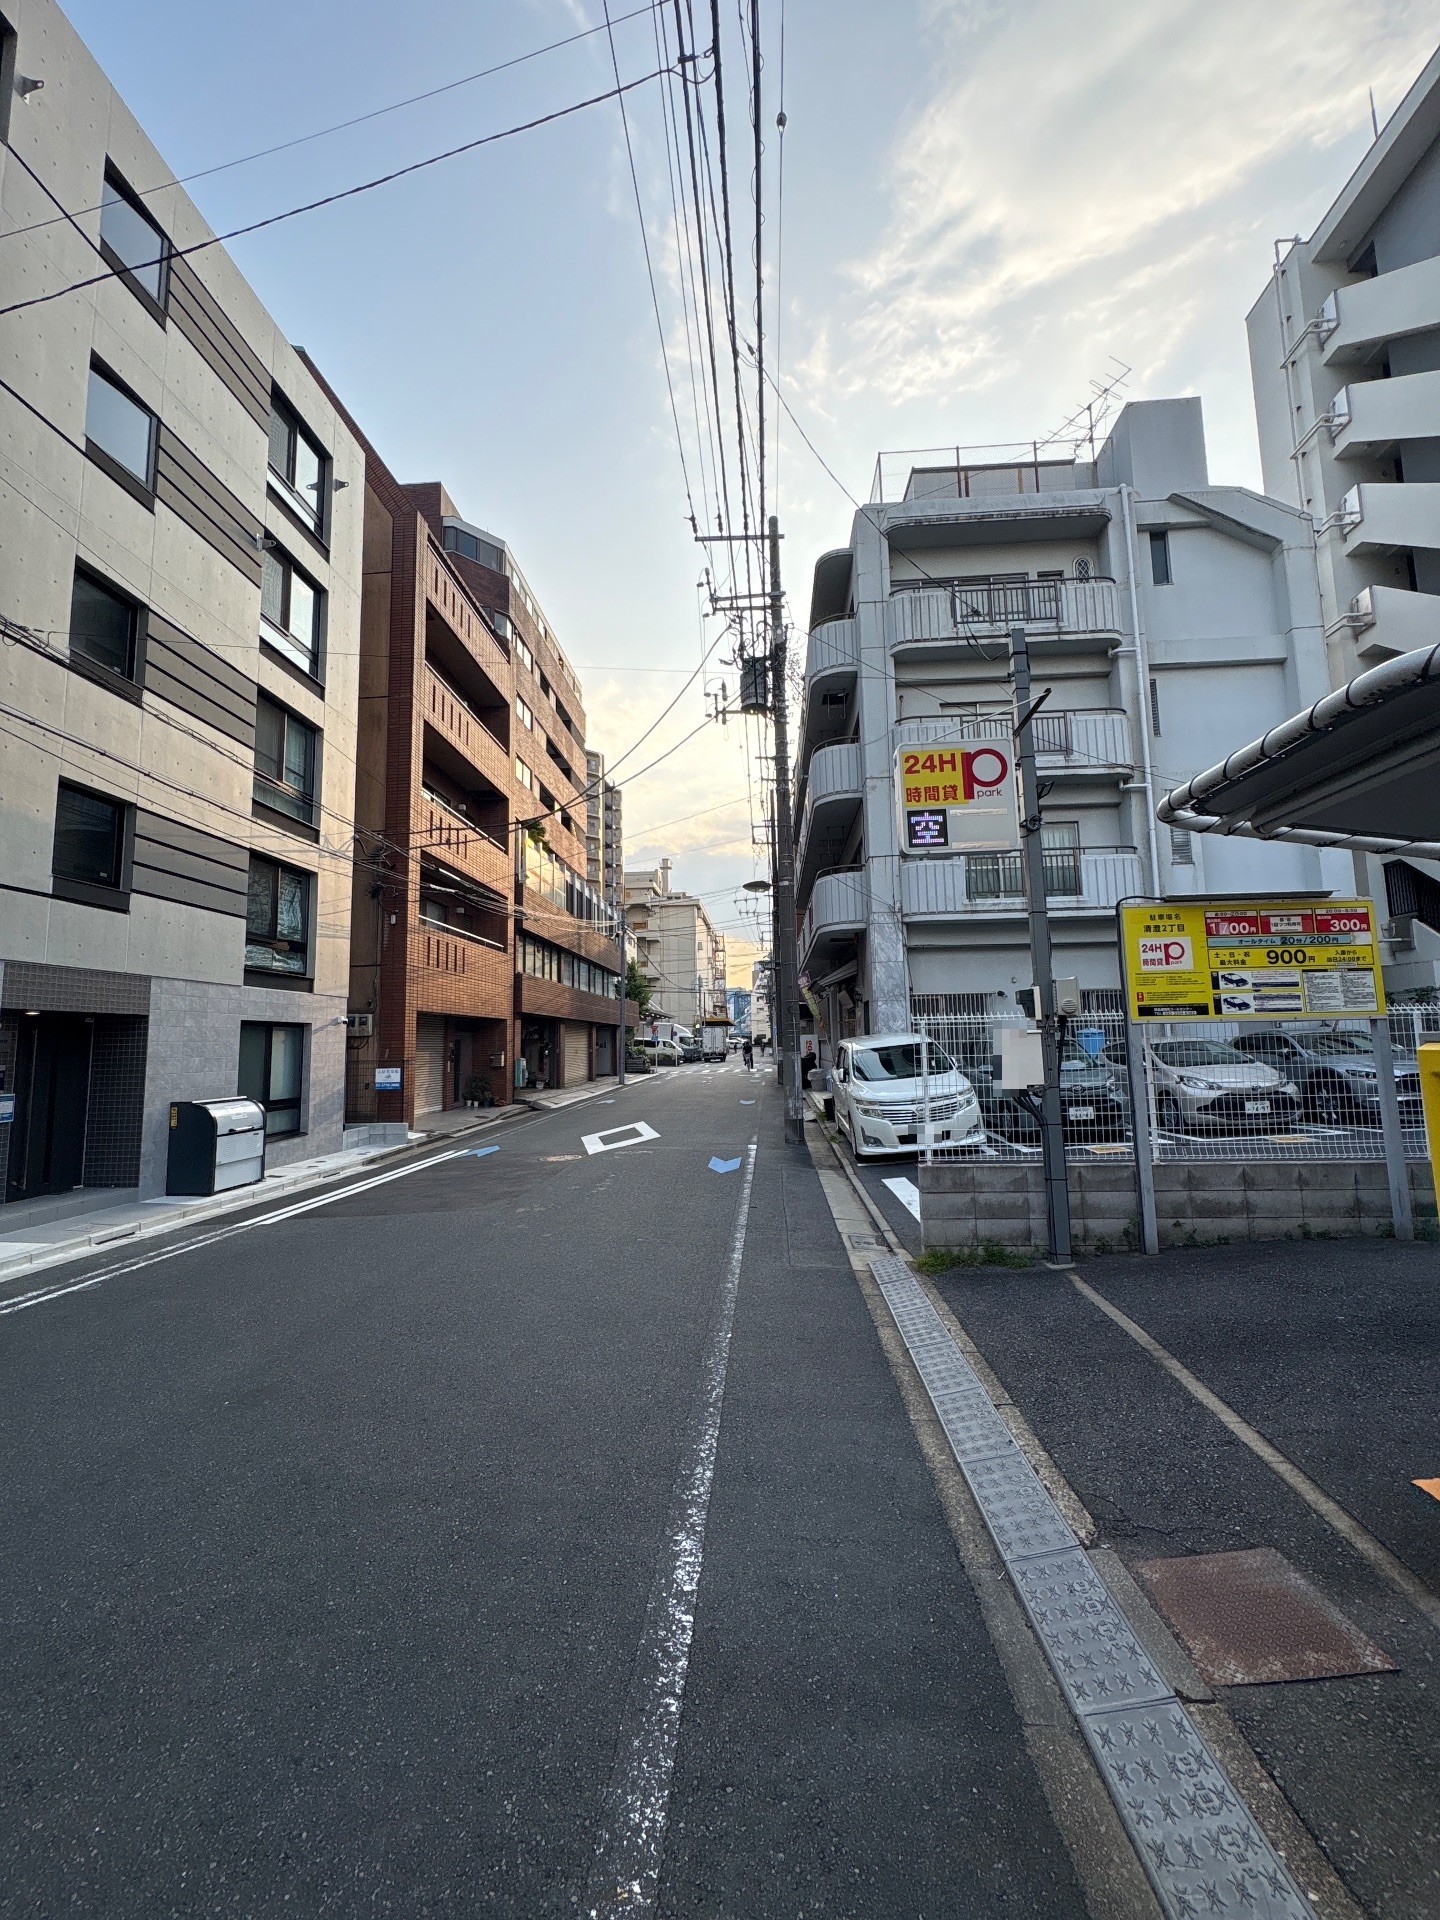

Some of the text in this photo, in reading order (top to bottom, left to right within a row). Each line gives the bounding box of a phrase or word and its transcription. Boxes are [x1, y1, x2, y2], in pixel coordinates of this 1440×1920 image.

[904, 752, 957, 775] 24H
[906, 784, 958, 803] 時間貸
[976, 788, 1002, 799] park
[910, 812, 944, 844] 空
[1141, 943, 1162, 954] 24H
